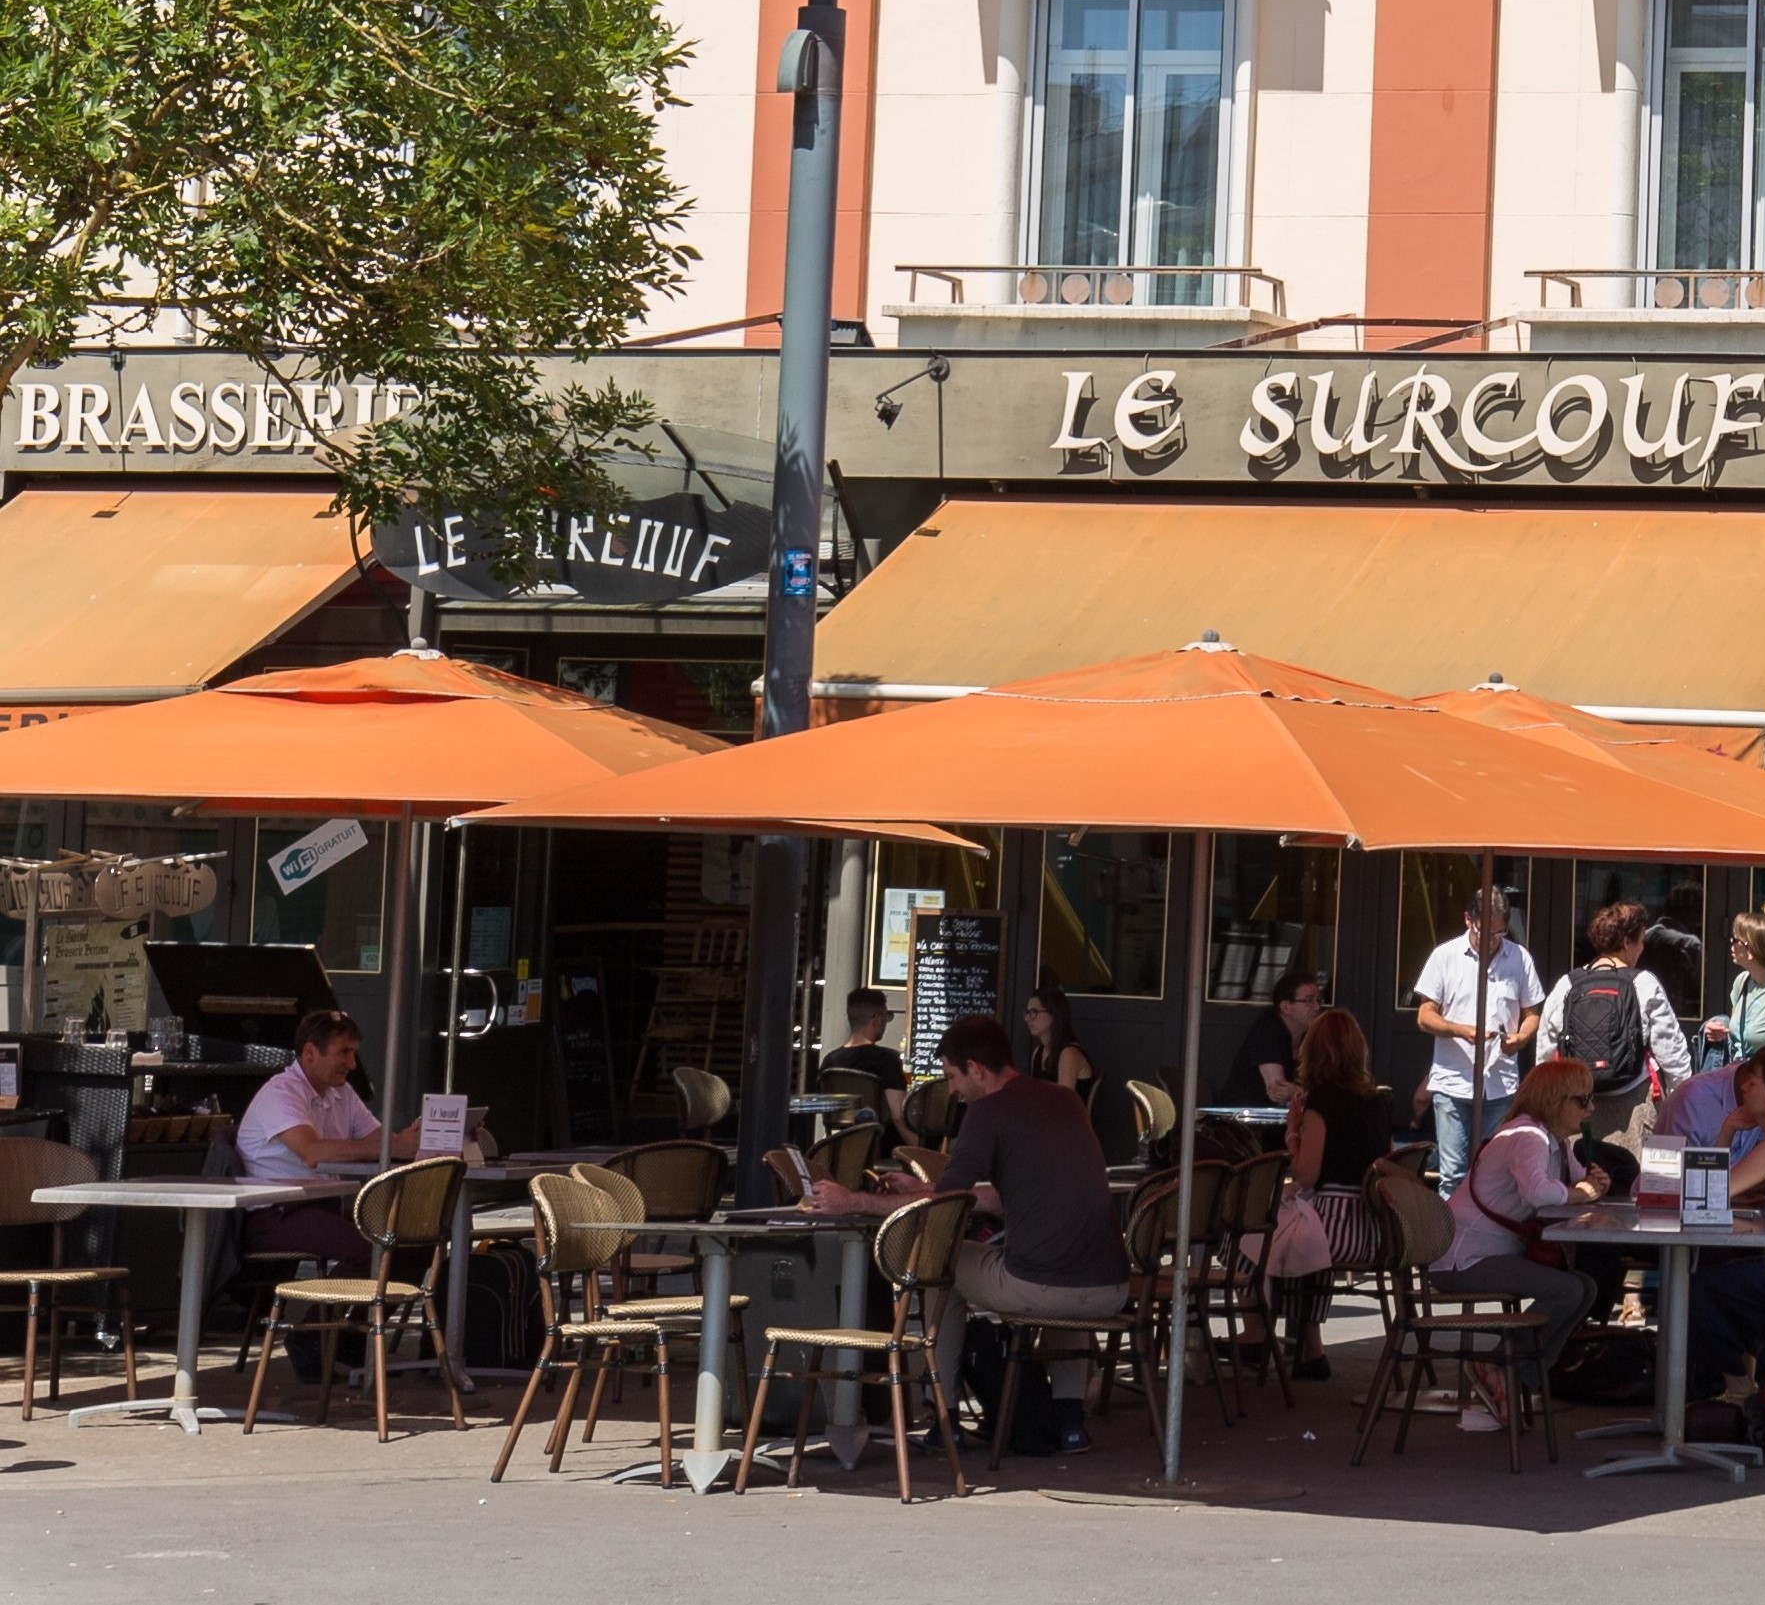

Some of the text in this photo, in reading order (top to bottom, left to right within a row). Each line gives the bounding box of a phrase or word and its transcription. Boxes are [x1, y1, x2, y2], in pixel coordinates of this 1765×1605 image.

[1050, 362, 1765, 473] LE SURCOUF
[414, 514, 466, 576] LE
[316, 824, 357, 856] GRATUIT
[135, 874, 202, 909] SURCOUF
